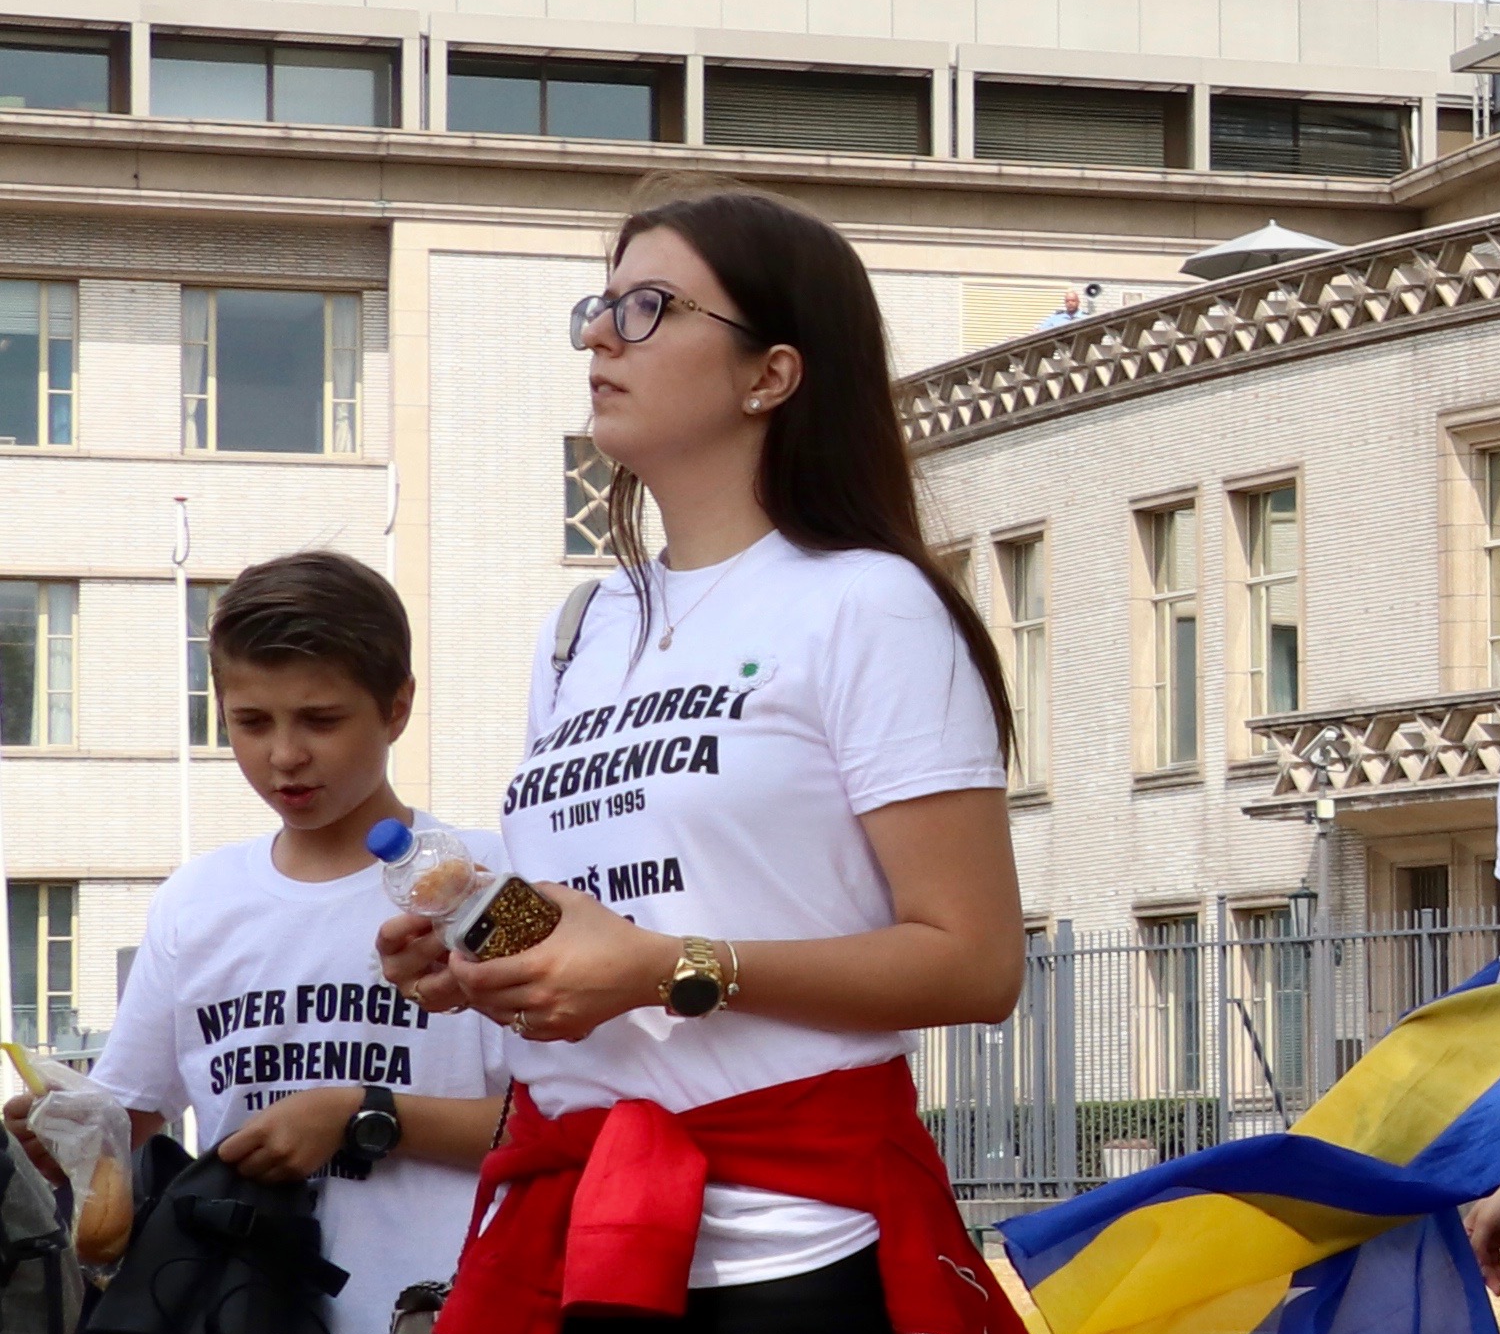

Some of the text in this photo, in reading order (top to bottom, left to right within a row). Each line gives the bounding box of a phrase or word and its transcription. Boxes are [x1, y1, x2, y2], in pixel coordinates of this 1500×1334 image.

[503, 735, 720, 816] SREBRENICA
[549, 788, 646, 833] 11 JULY 1995
[608, 857, 685, 903] MIRA
[196, 990, 287, 1045] NEVER
[210, 1041, 412, 1095] SREBRENICA
[243, 1090, 264, 1111] 11
